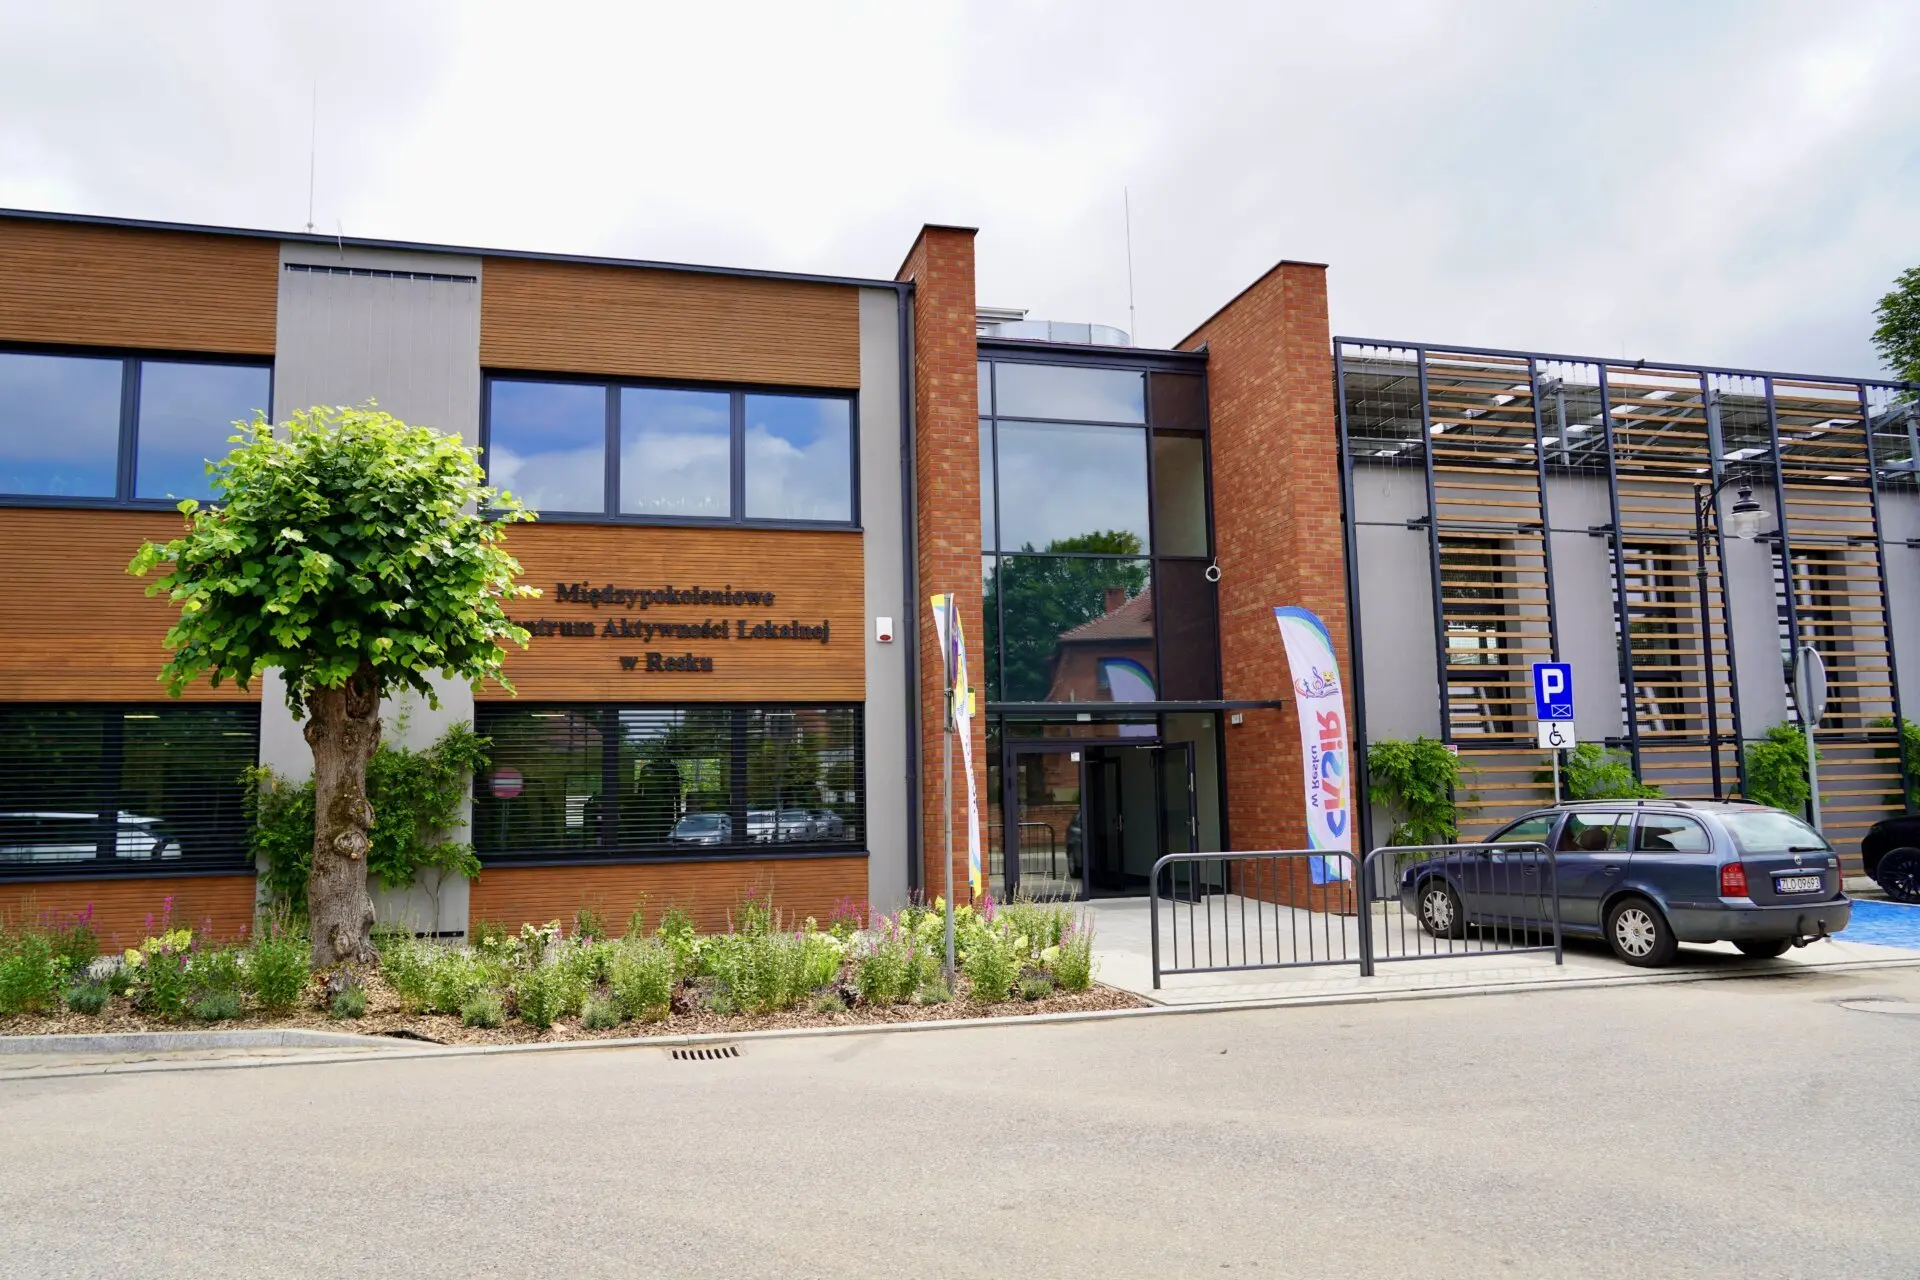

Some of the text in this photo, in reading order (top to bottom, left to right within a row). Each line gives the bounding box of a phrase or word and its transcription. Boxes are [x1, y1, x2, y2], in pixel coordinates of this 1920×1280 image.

[556, 581, 776, 609] Międzypokoleniowe
[503, 616, 830, 644] ntrum Aktywności Lokalnej
[619, 651, 713, 672] w Resku
[1541, 668, 1564, 704] P
